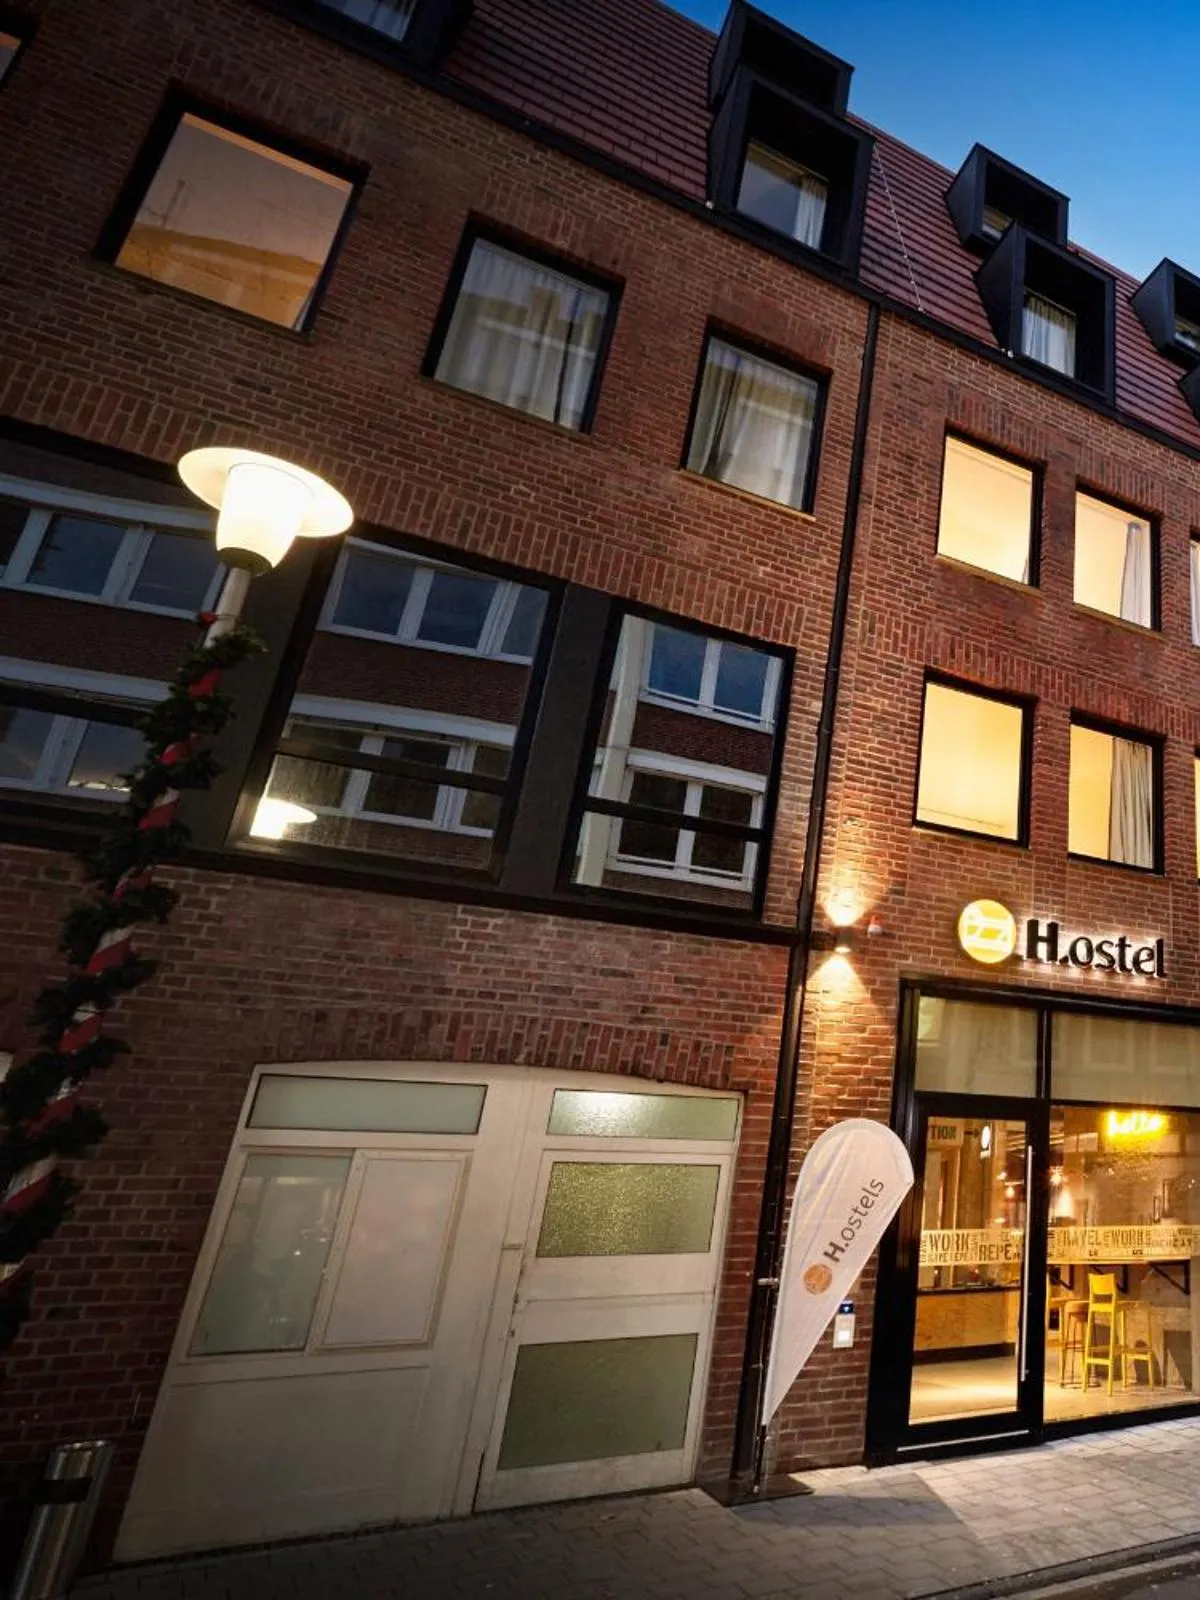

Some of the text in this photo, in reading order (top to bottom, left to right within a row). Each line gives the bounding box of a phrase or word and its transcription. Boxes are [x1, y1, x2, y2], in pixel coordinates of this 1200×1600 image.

[1026, 918, 1168, 978] H.ostel
[822, 1178, 885, 1263] H.ostels
[928, 1231, 970, 1252] WORK
